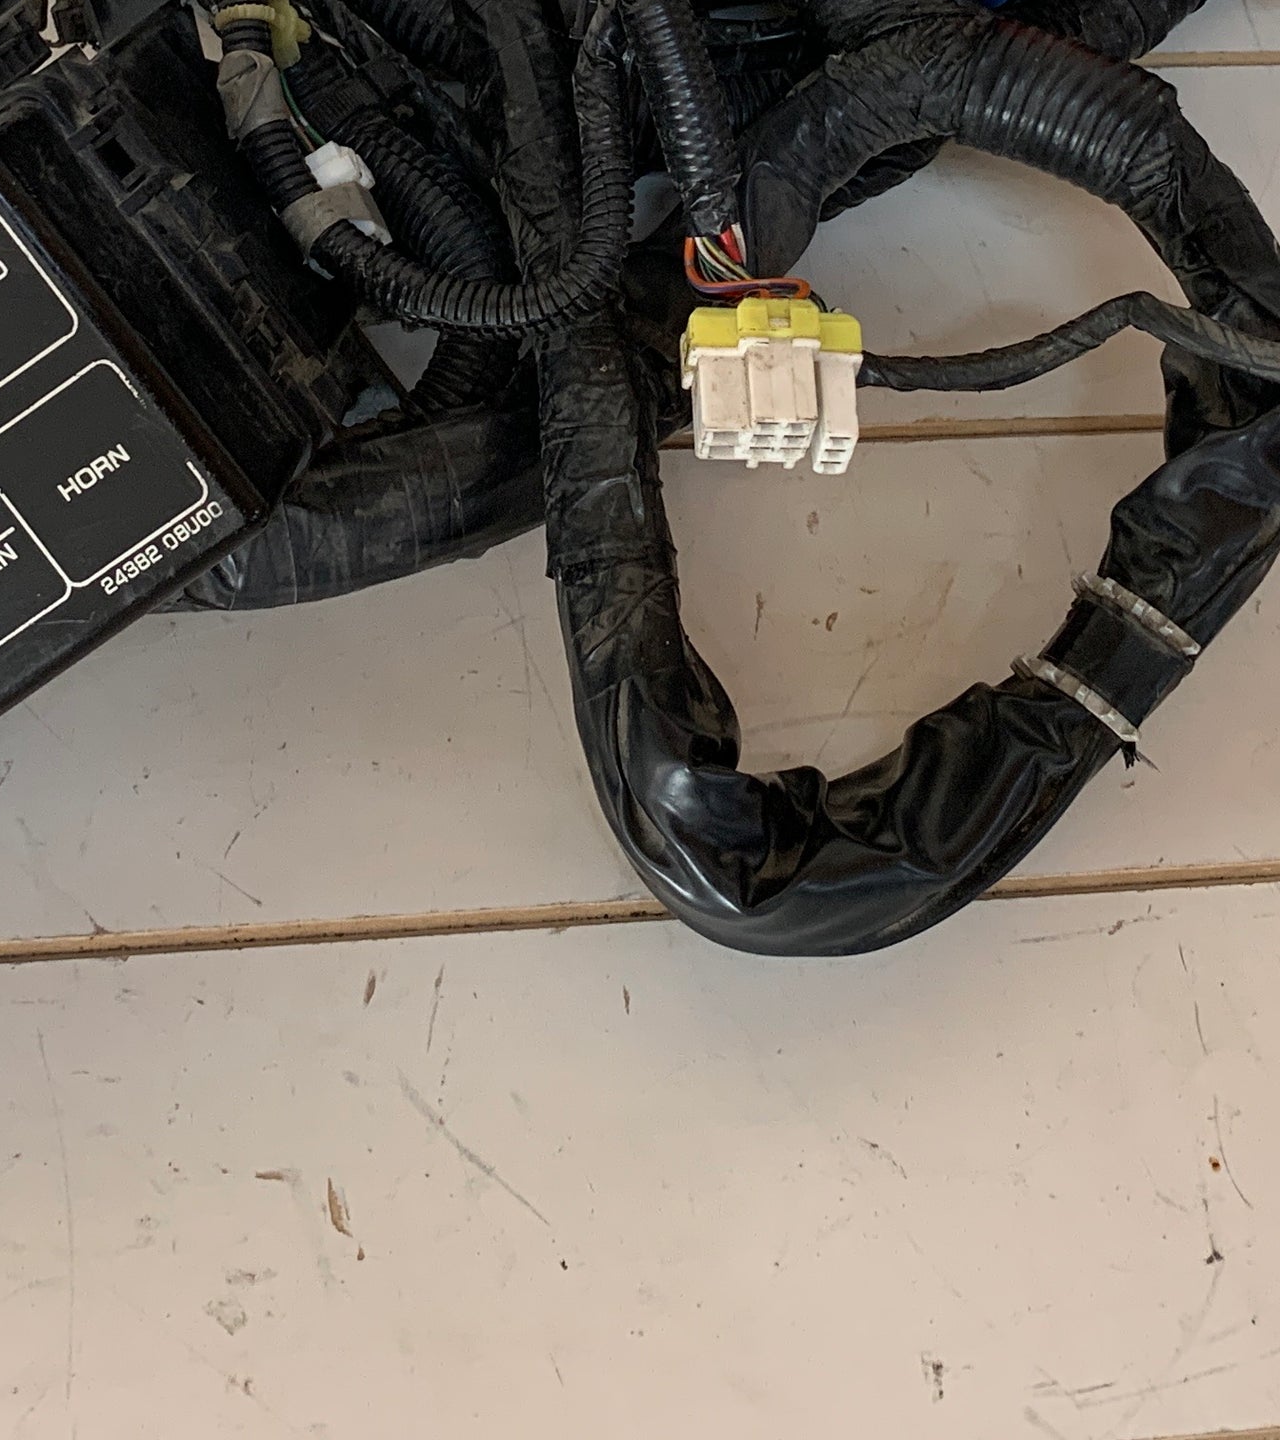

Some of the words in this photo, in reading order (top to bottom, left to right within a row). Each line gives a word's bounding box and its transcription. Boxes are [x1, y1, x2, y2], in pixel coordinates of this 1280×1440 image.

[55, 442, 132, 503] HORN
[99, 543, 164, 596] 24382
[160, 500, 224, 552] 08U00
